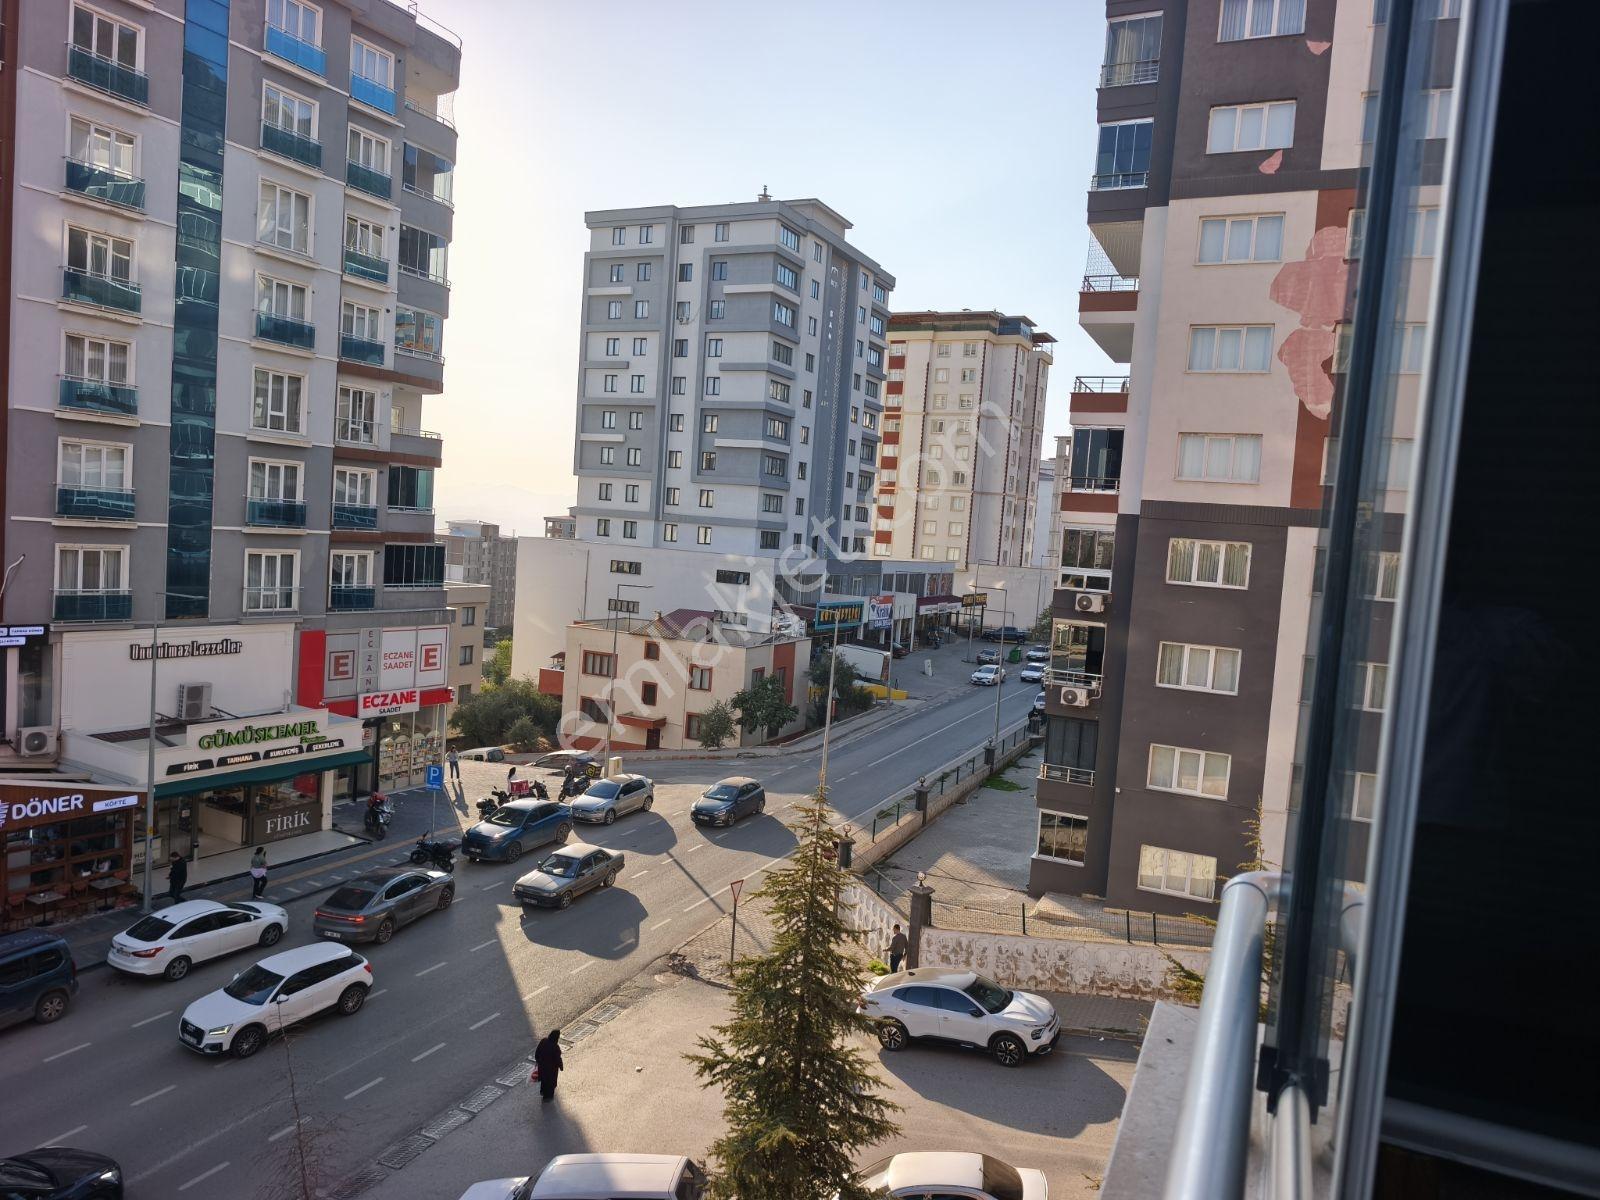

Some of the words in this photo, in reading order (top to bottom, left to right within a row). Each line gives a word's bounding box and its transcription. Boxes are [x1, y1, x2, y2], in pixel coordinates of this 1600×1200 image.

[130, 643, 190, 660] Unuulmaz
[383, 651, 413, 660] ECZANE
[424, 648, 437, 667] E
[383, 661, 413, 670] SAADET
[362, 691, 417, 709] ECZANE
[379, 706, 402, 714] SAADET
[226, 754, 253, 765] TARHANA
[183, 763, 199, 772] FİRİK
[431, 767, 440, 780] P
[12, 794, 84, 820] DÖNER
[265, 810, 311, 834] FİRİK
